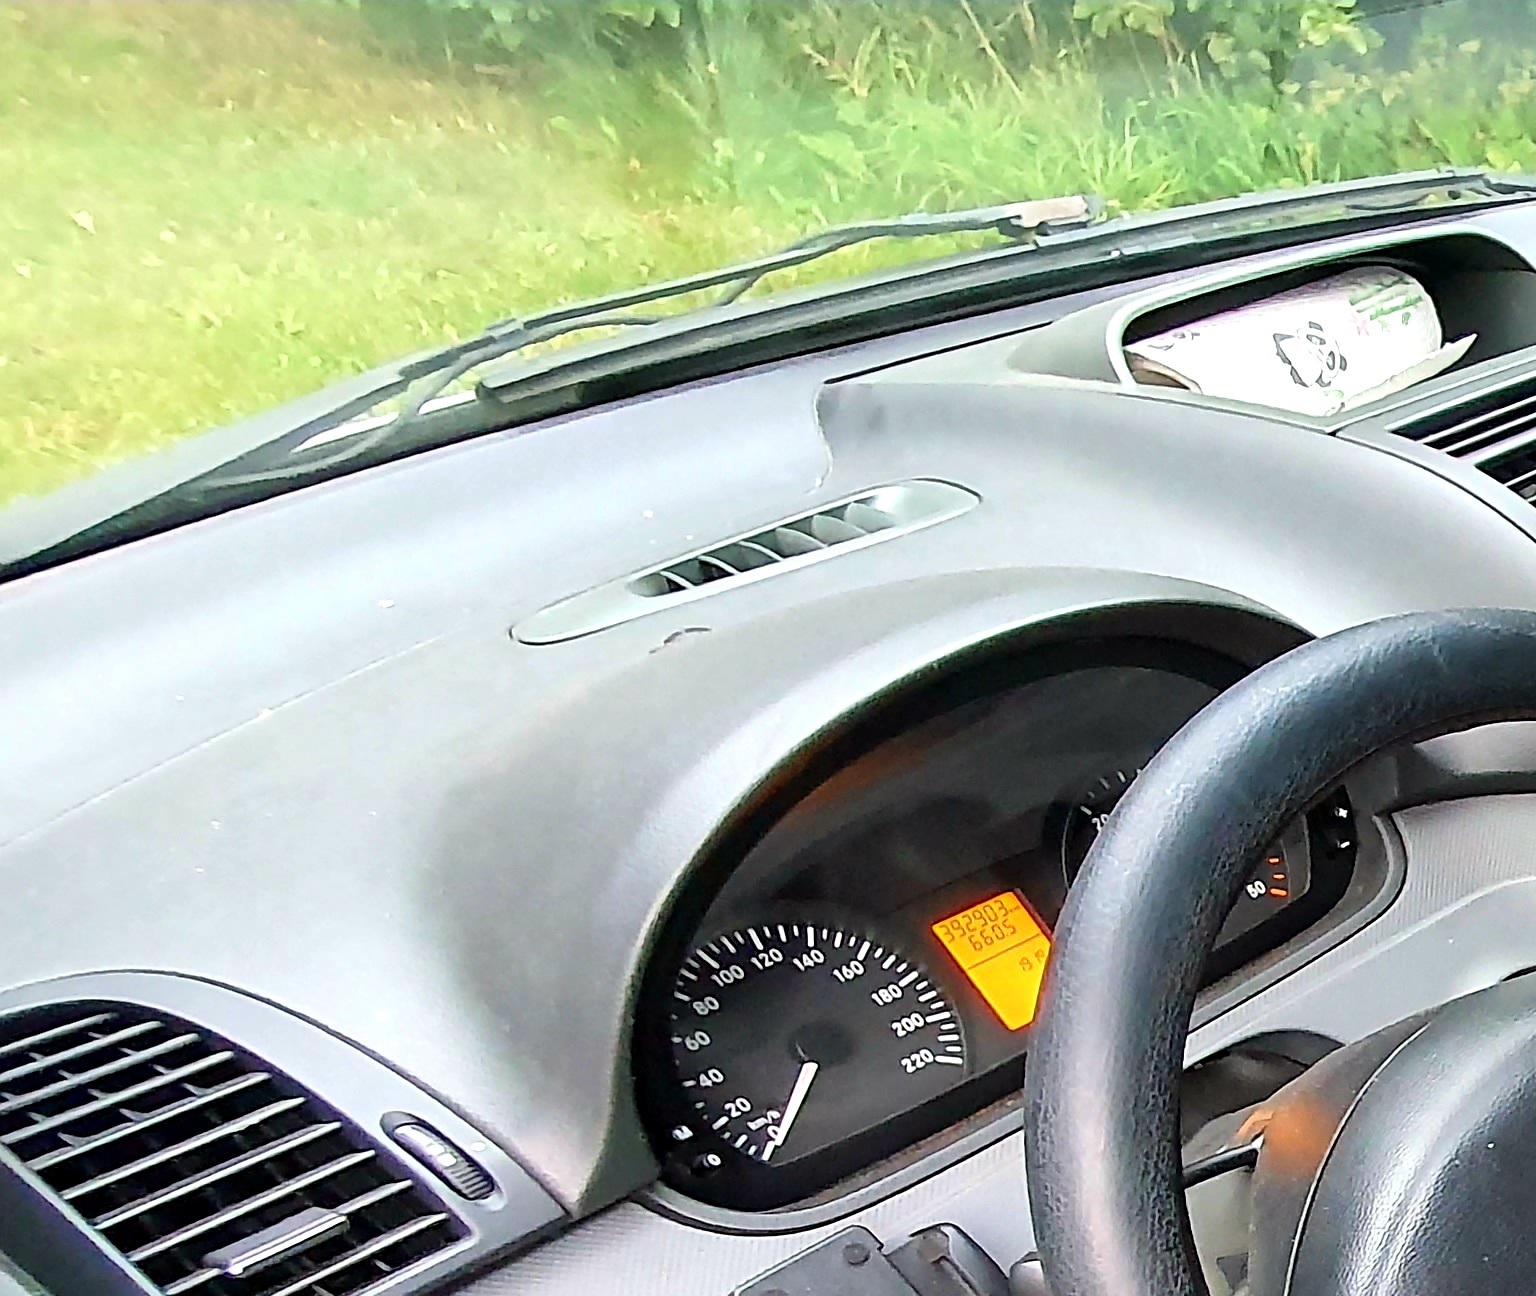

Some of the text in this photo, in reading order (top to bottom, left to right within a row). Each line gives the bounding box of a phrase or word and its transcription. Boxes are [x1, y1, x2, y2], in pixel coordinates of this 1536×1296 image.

[940, 900, 1009, 943] 392903
[751, 948, 783, 970] 120
[792, 949, 825, 972] 140
[711, 964, 745, 987] 100
[832, 960, 865, 983] 160
[693, 996, 719, 1015] 80
[871, 984, 903, 1006] 180
[891, 1013, 925, 1037] 200
[684, 1031, 711, 1051] 60
[901, 1049, 934, 1073] 220
[699, 1068, 724, 1088] 40
[724, 1097, 751, 1118] 20
